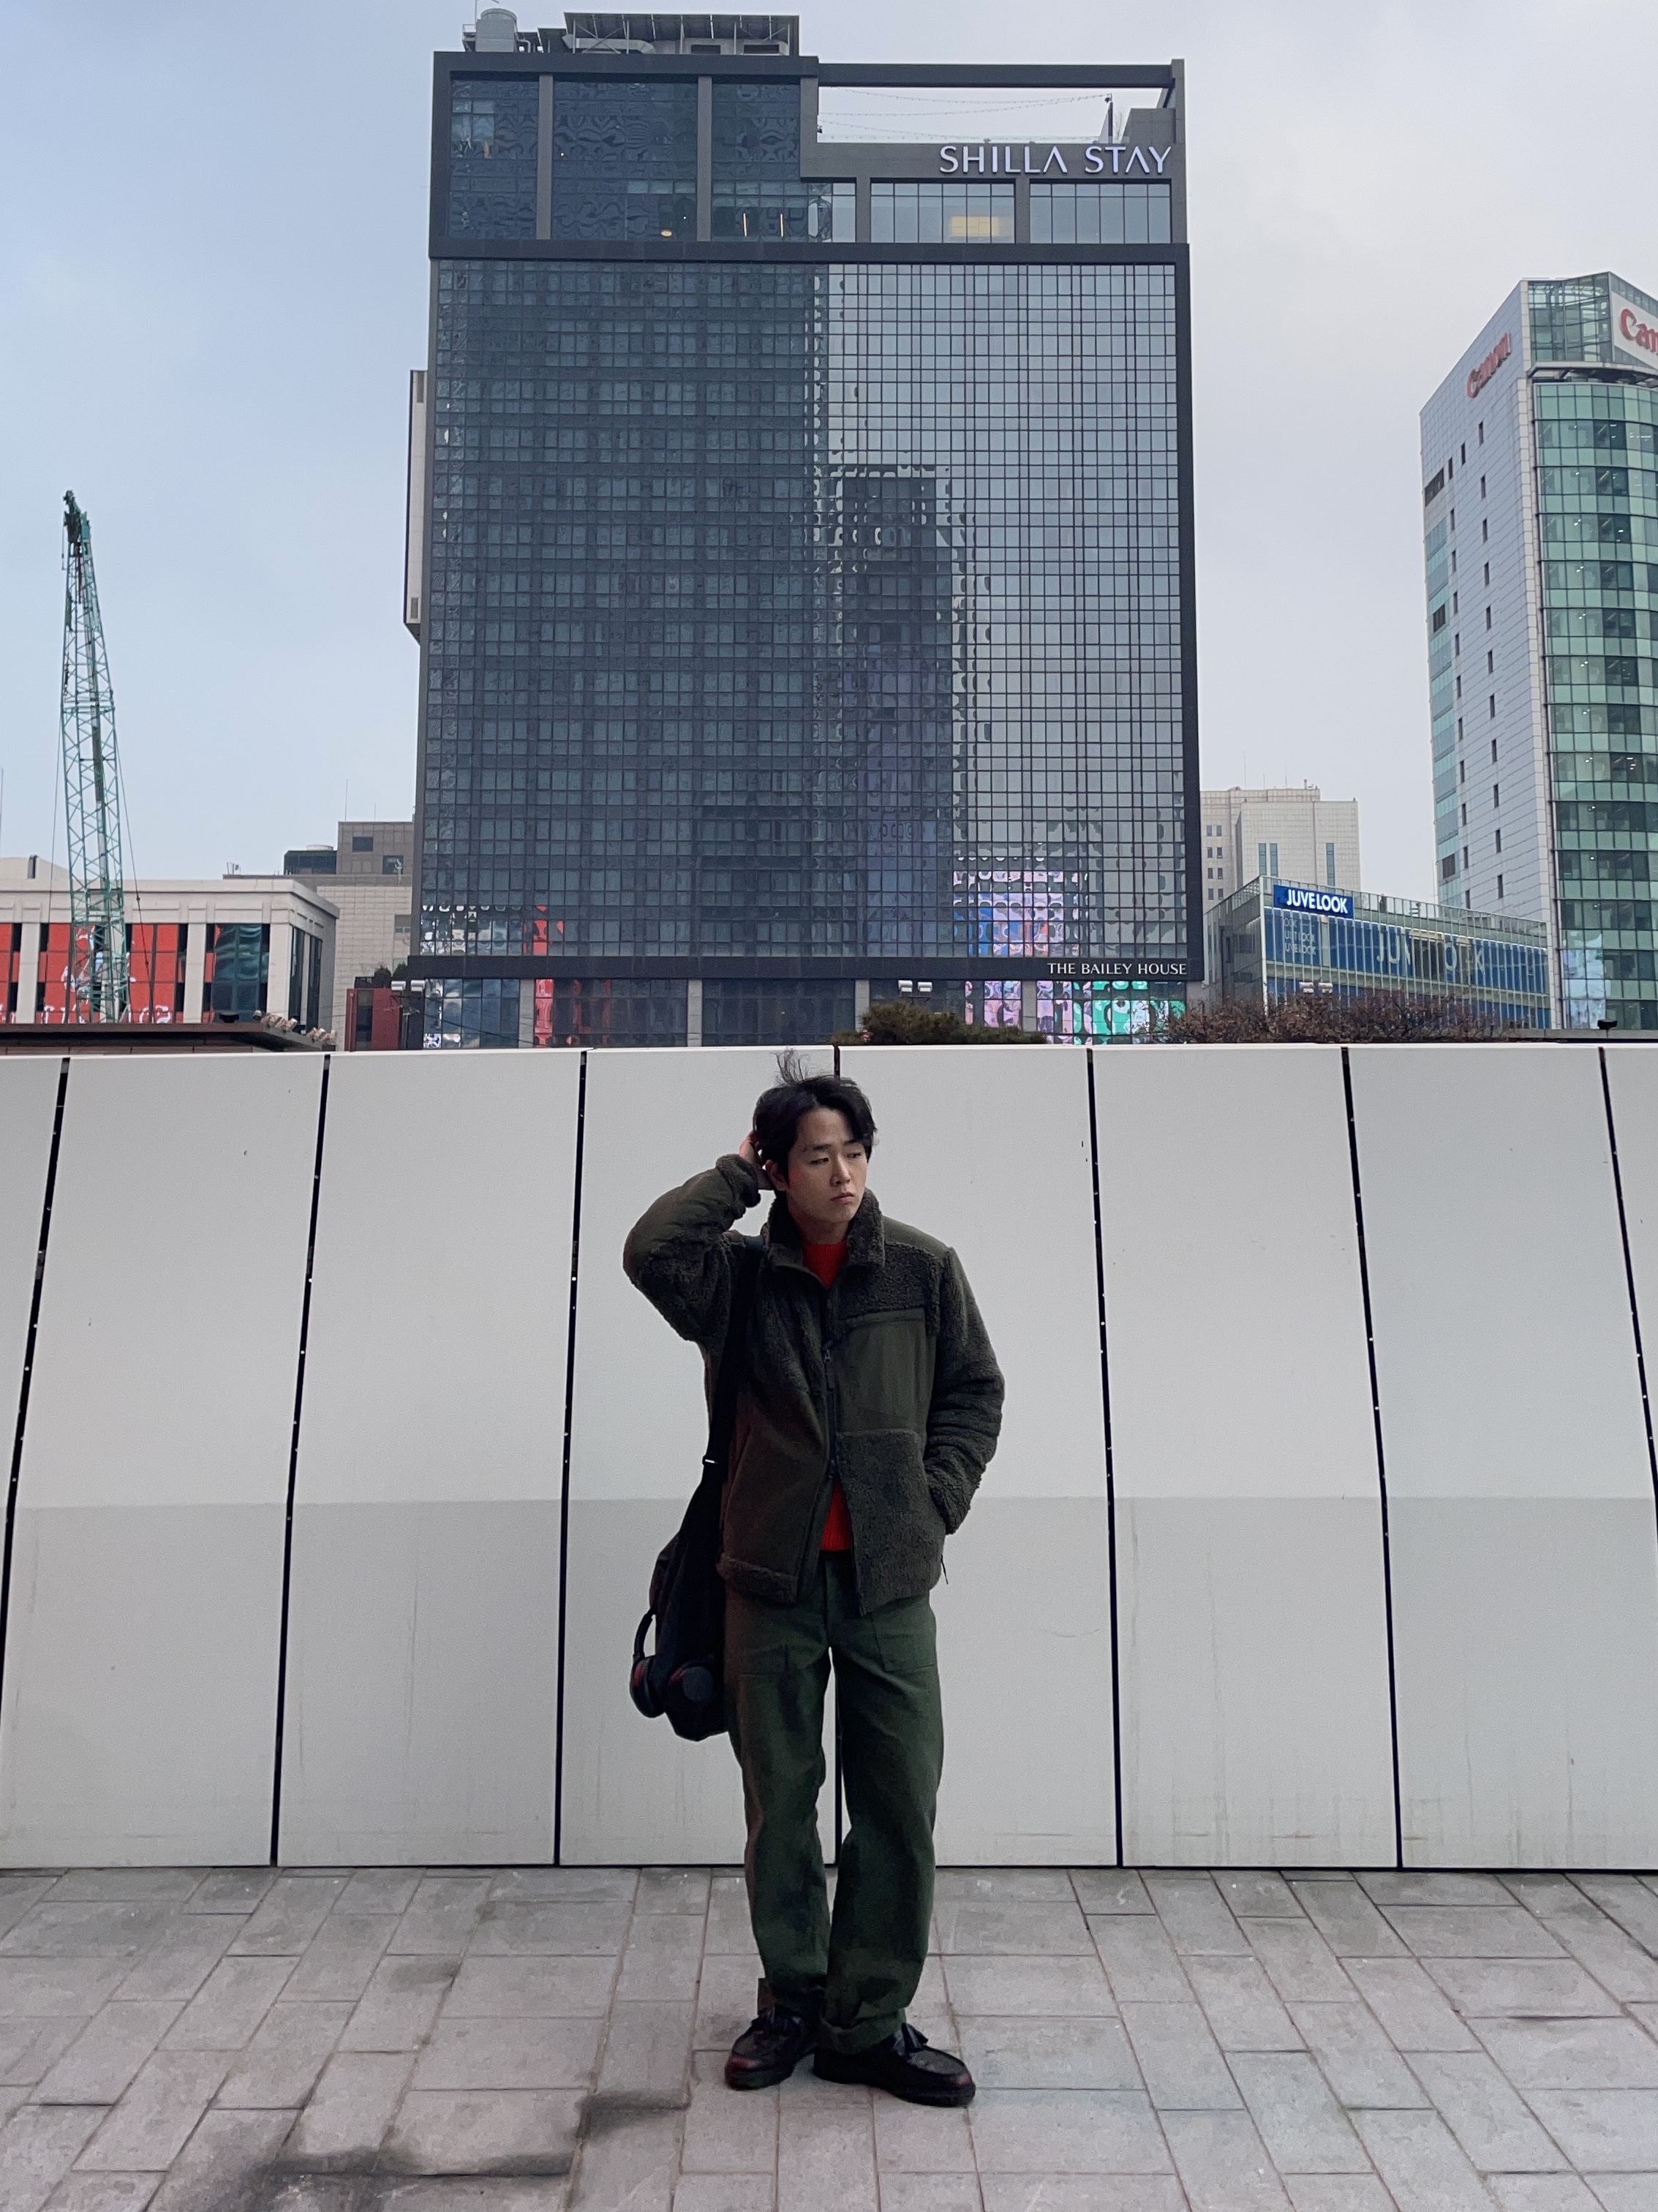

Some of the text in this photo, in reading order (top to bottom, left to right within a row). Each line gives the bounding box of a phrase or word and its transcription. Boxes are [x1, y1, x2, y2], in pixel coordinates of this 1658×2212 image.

[939, 146, 1172, 173] SHILLA STAY
[1286, 888, 1349, 914] JUVELOOK
[1047, 962, 1188, 975] THE BAILEY HOUSE
